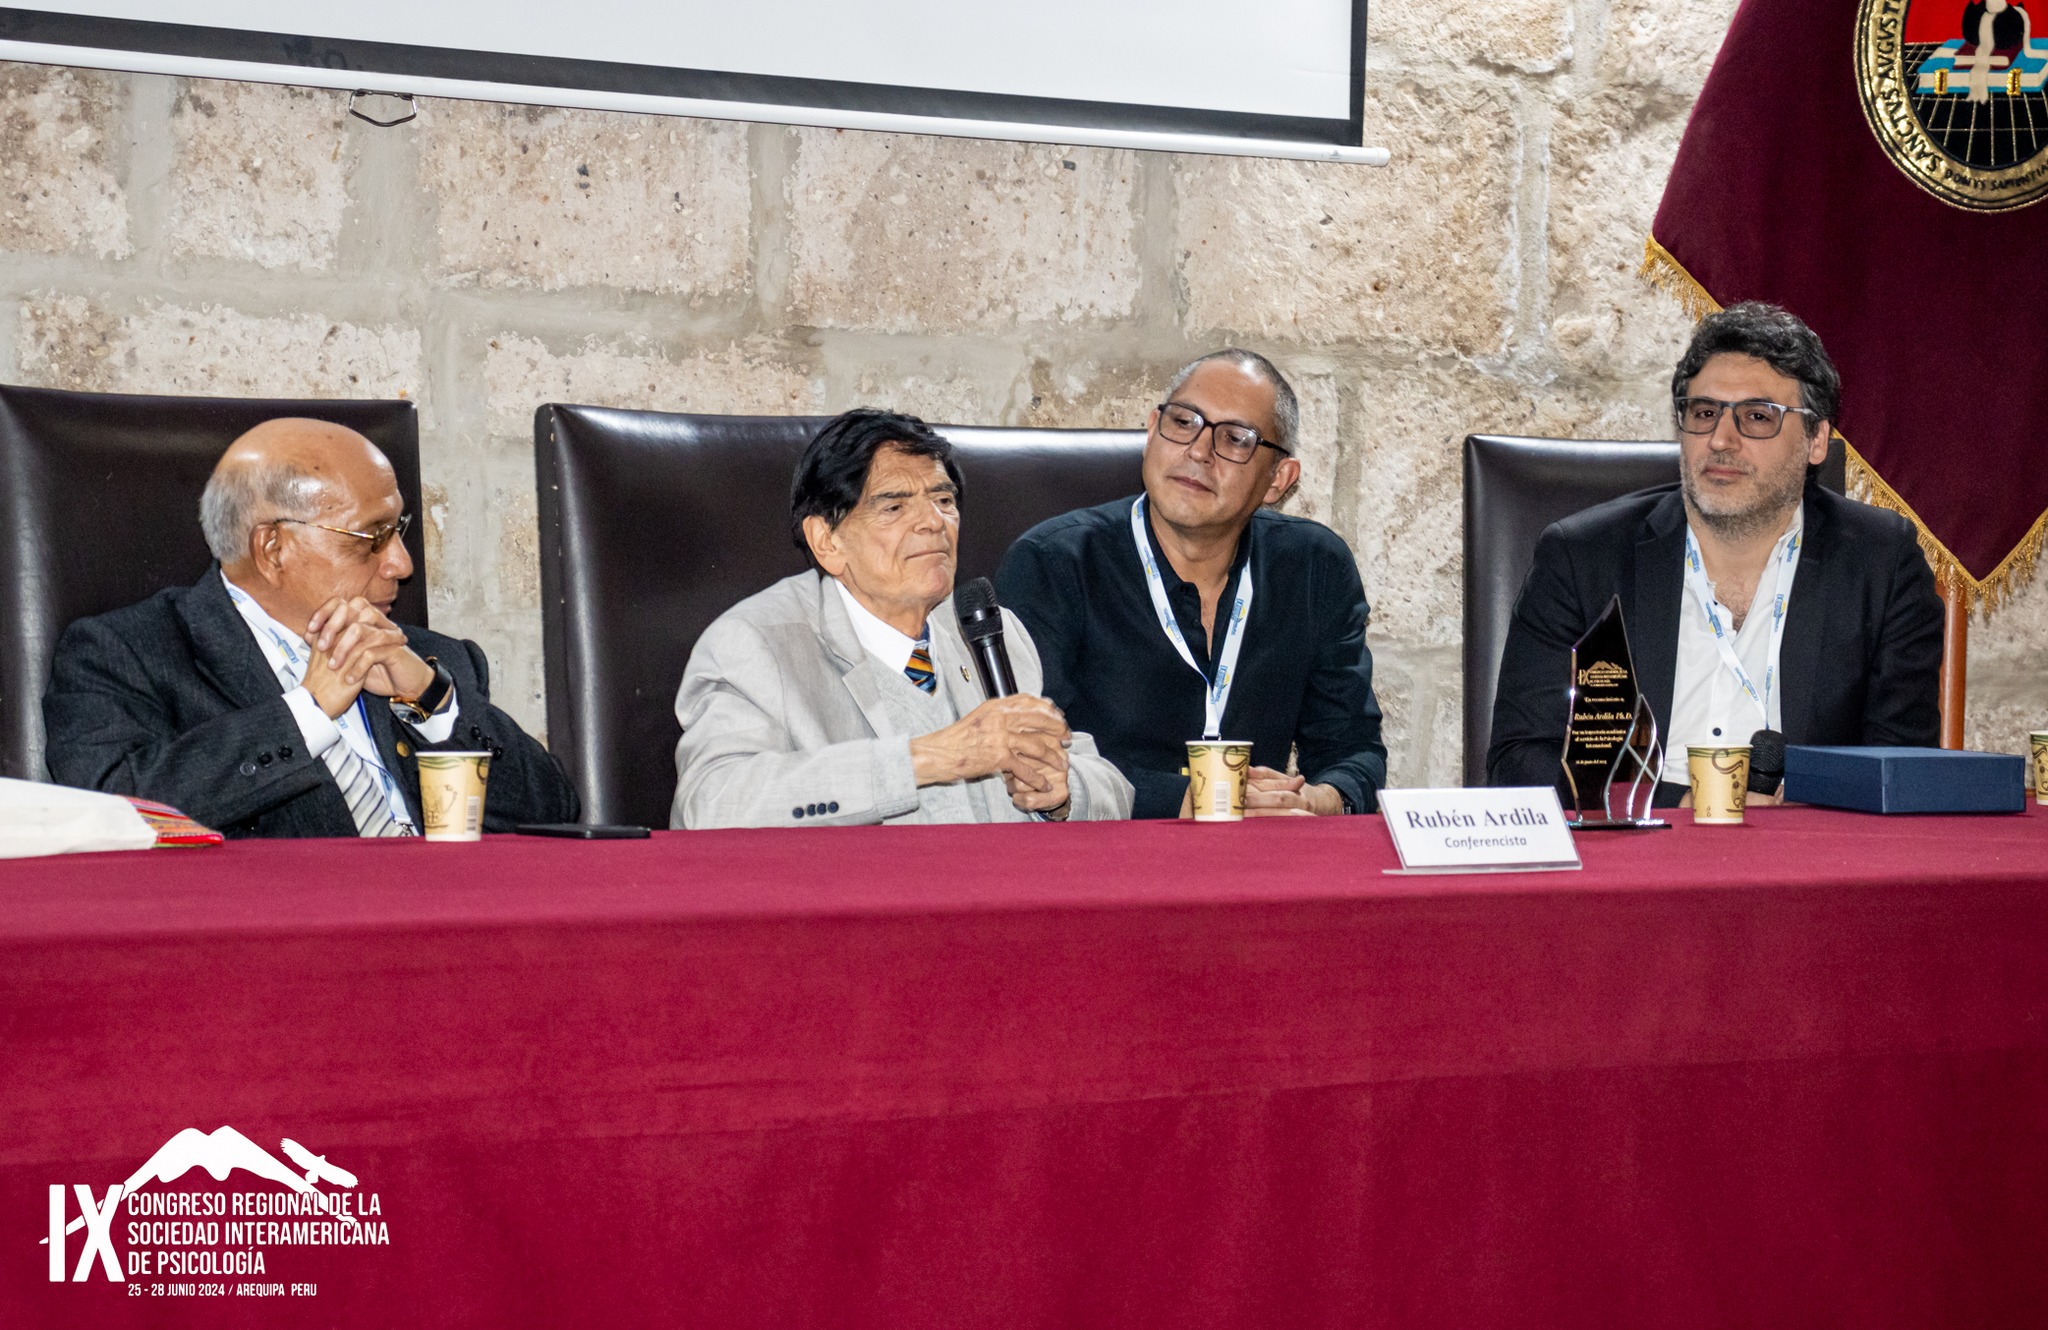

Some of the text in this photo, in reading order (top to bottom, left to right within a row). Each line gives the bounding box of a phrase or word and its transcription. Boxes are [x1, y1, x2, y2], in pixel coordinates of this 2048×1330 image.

[1405, 808, 1549, 829] Rubén Ardila
[1444, 836, 1527, 850] Conferencista
